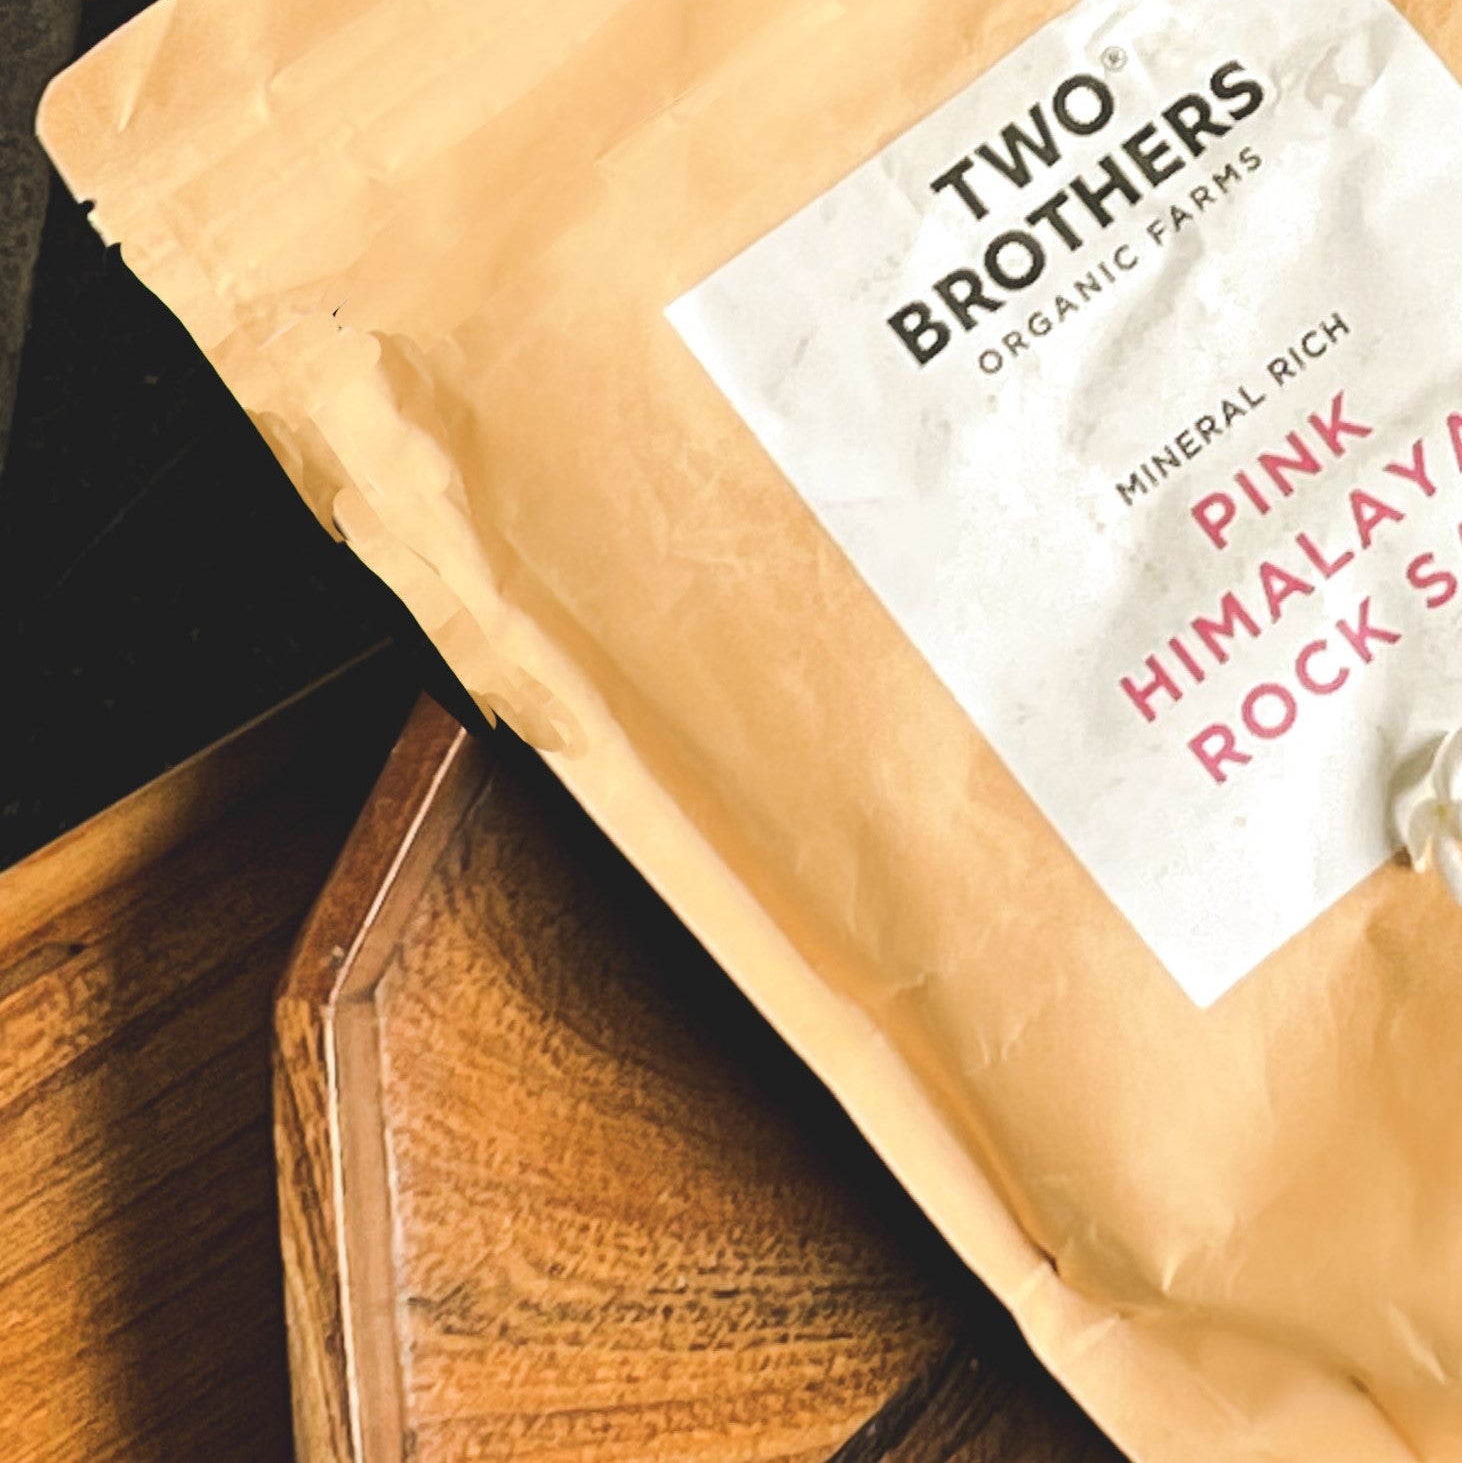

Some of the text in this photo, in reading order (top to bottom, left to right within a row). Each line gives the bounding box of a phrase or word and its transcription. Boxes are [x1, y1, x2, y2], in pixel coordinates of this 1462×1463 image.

[886, 58, 1265, 367] BROTHERS
[978, 145, 1264, 375] ORGANIC FARMS
[1114, 311, 1351, 507] MINERAL RICH
[1190, 389, 1374, 551] PINK
[1186, 595, 1403, 785] ROCK
